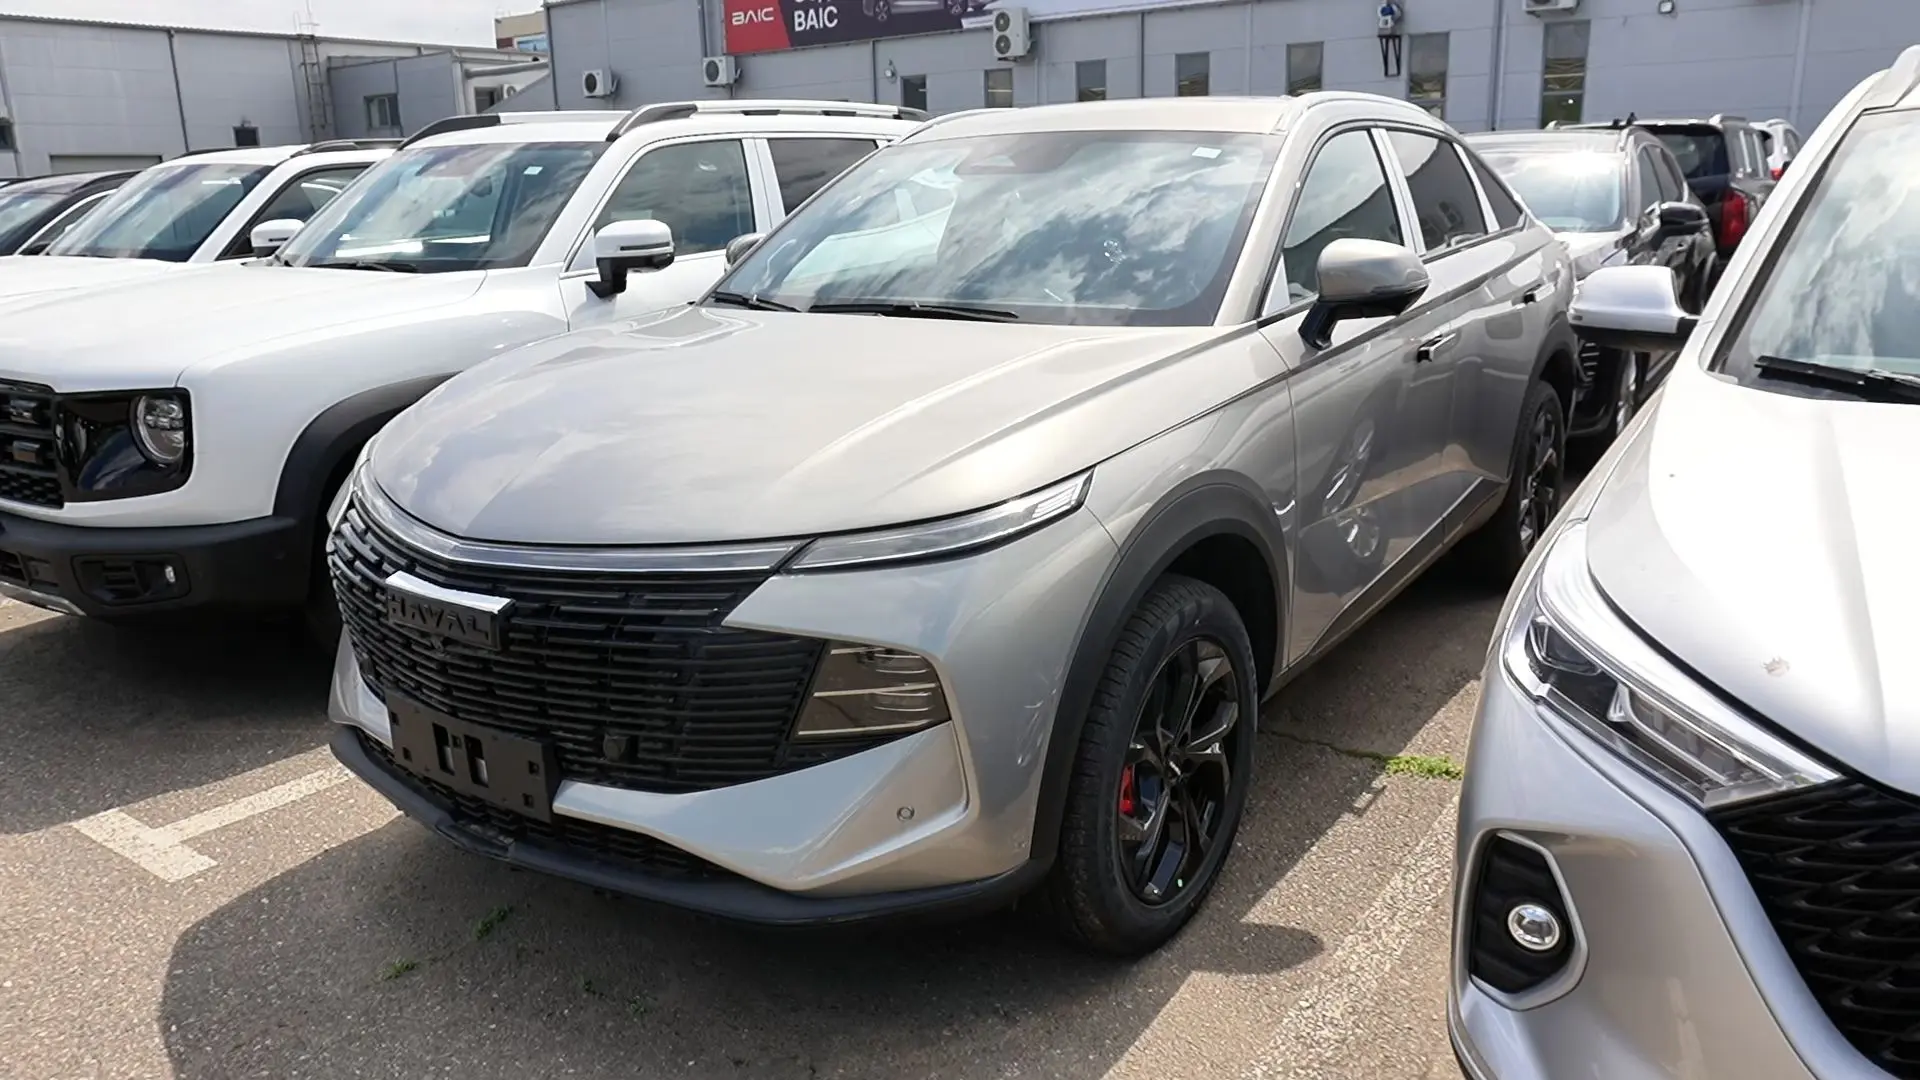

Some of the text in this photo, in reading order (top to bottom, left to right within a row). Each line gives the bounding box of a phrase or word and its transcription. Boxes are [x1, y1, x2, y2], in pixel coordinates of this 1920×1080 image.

[732, 7, 774, 25] BAIC
[794, 5, 838, 32] BAIC
[389, 592, 489, 641] HAVAL
